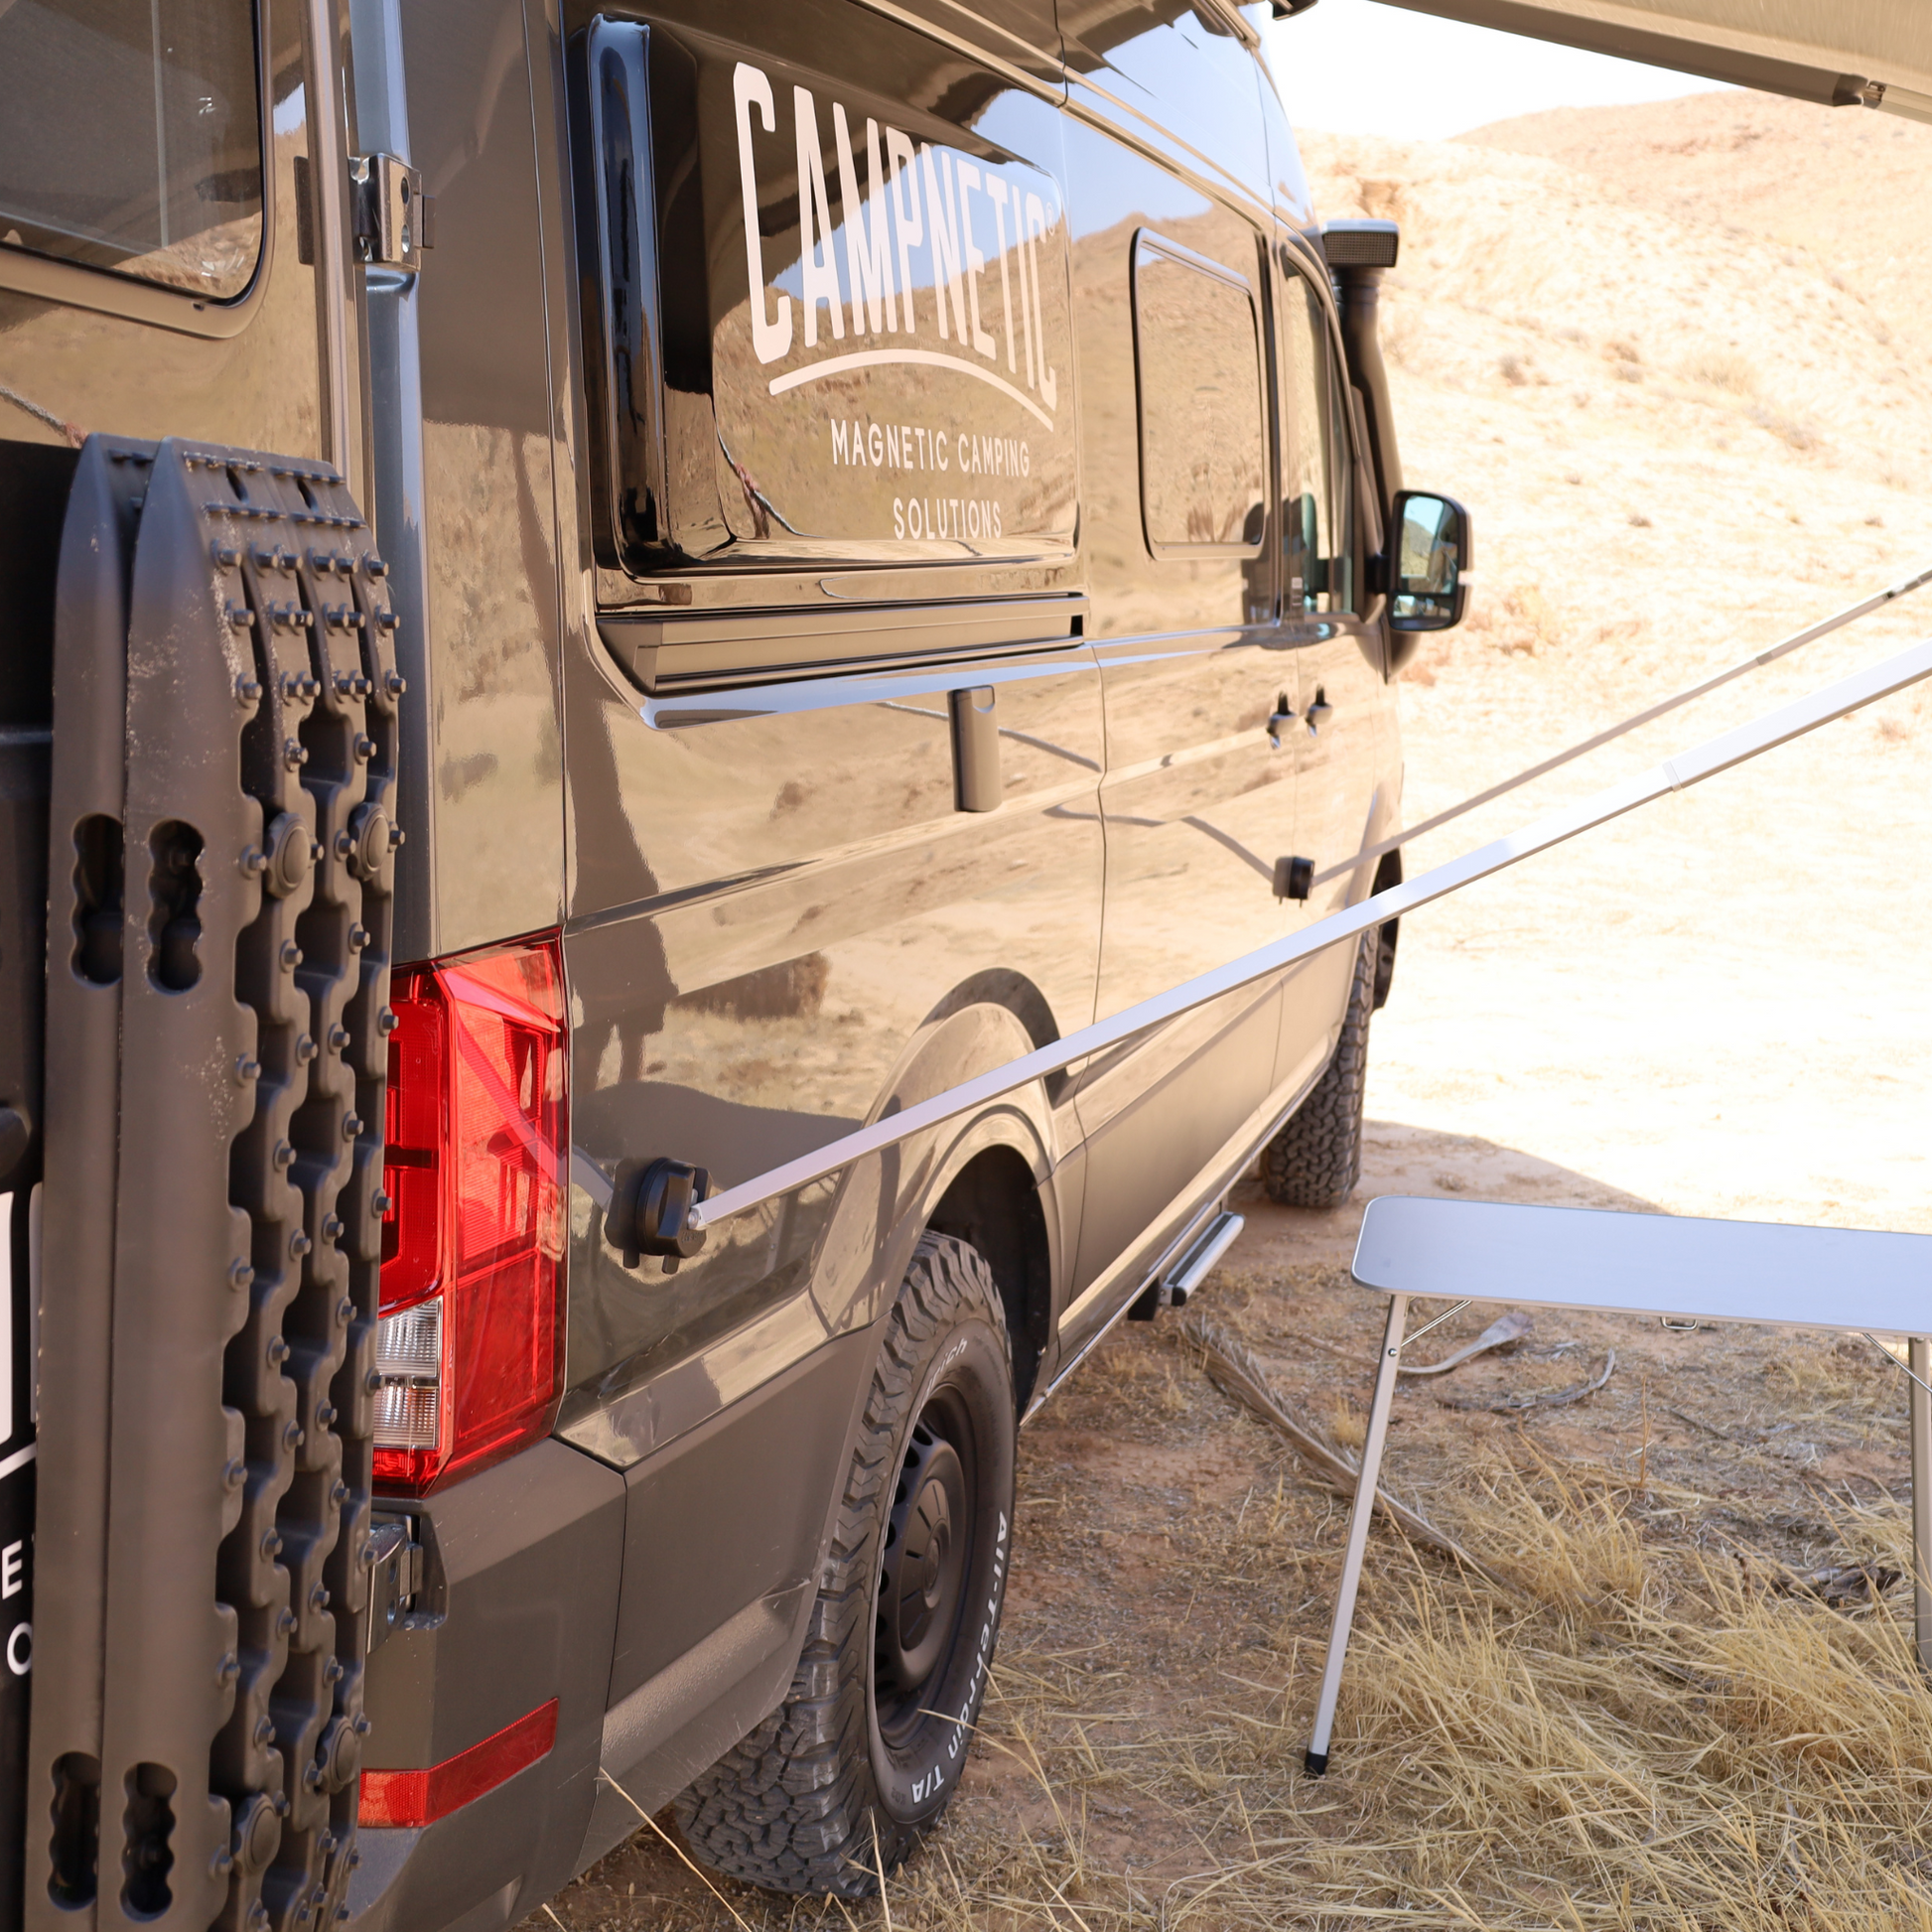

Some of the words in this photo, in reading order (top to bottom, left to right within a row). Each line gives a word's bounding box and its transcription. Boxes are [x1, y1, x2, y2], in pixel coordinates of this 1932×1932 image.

[830, 418, 949, 472] MAGNETIC
[957, 433, 1031, 478] CAMPING
[894, 496, 1002, 540] SOLUTIONS
[911, 1764, 945, 1804] T/A
